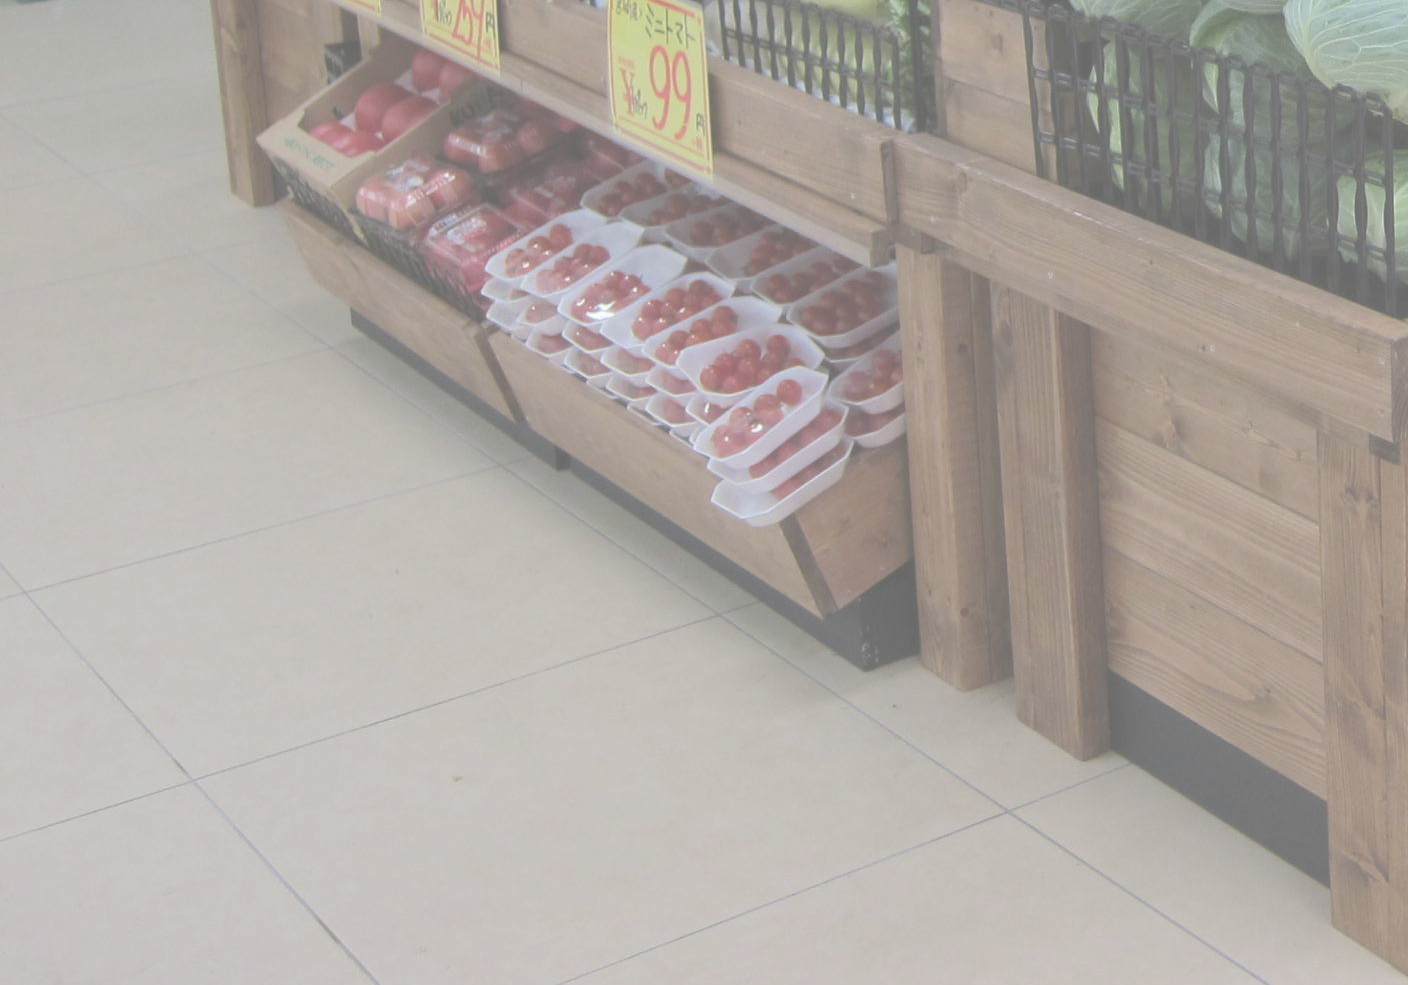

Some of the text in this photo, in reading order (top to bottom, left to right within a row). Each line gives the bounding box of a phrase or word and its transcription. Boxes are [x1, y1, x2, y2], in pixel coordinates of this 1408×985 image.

[644, 2, 696, 50] ミニトマト
[649, 44, 693, 141] 99
